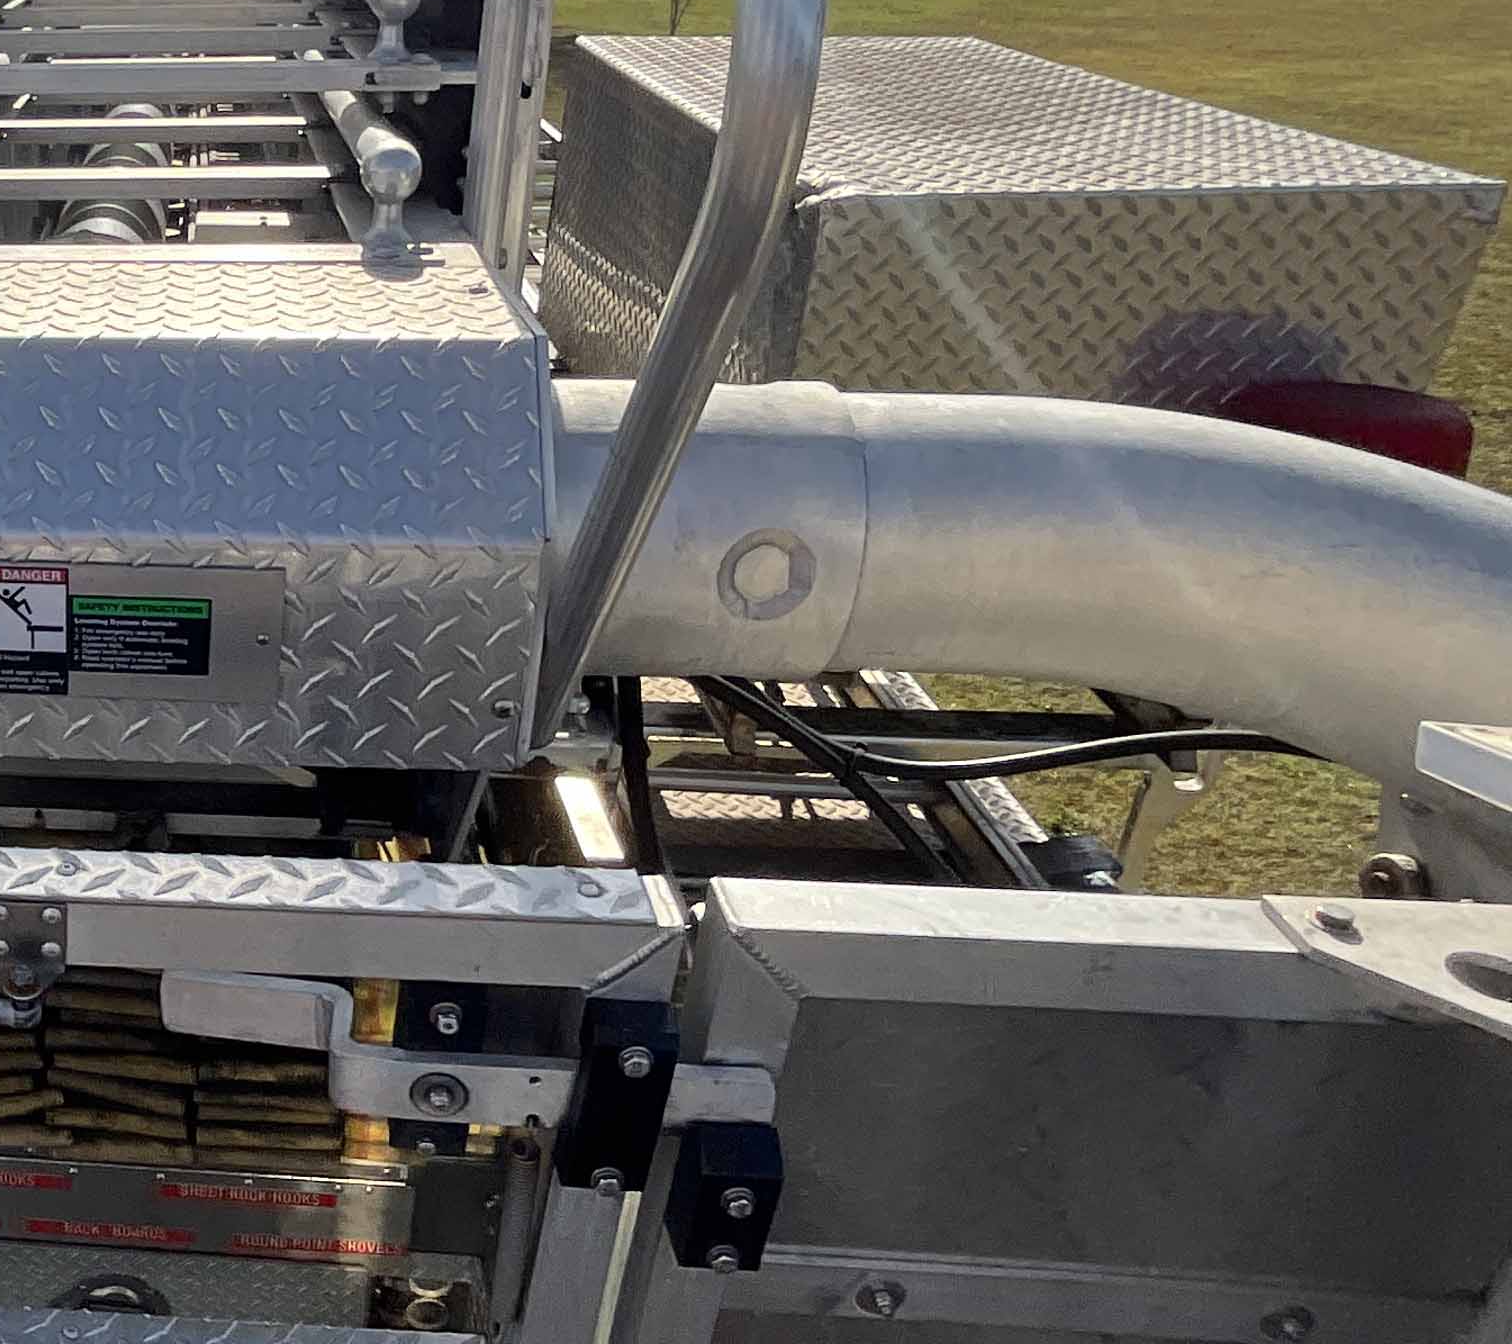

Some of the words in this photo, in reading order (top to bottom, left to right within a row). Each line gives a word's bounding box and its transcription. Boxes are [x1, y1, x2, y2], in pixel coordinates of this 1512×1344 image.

[1, 568, 62, 582] DANGER
[178, 1183, 226, 1200] SHEET
[272, 1191, 321, 1207] HOOKS
[290, 1236, 336, 1252] POINT
[337, 1238, 402, 1255] SHOVELS
